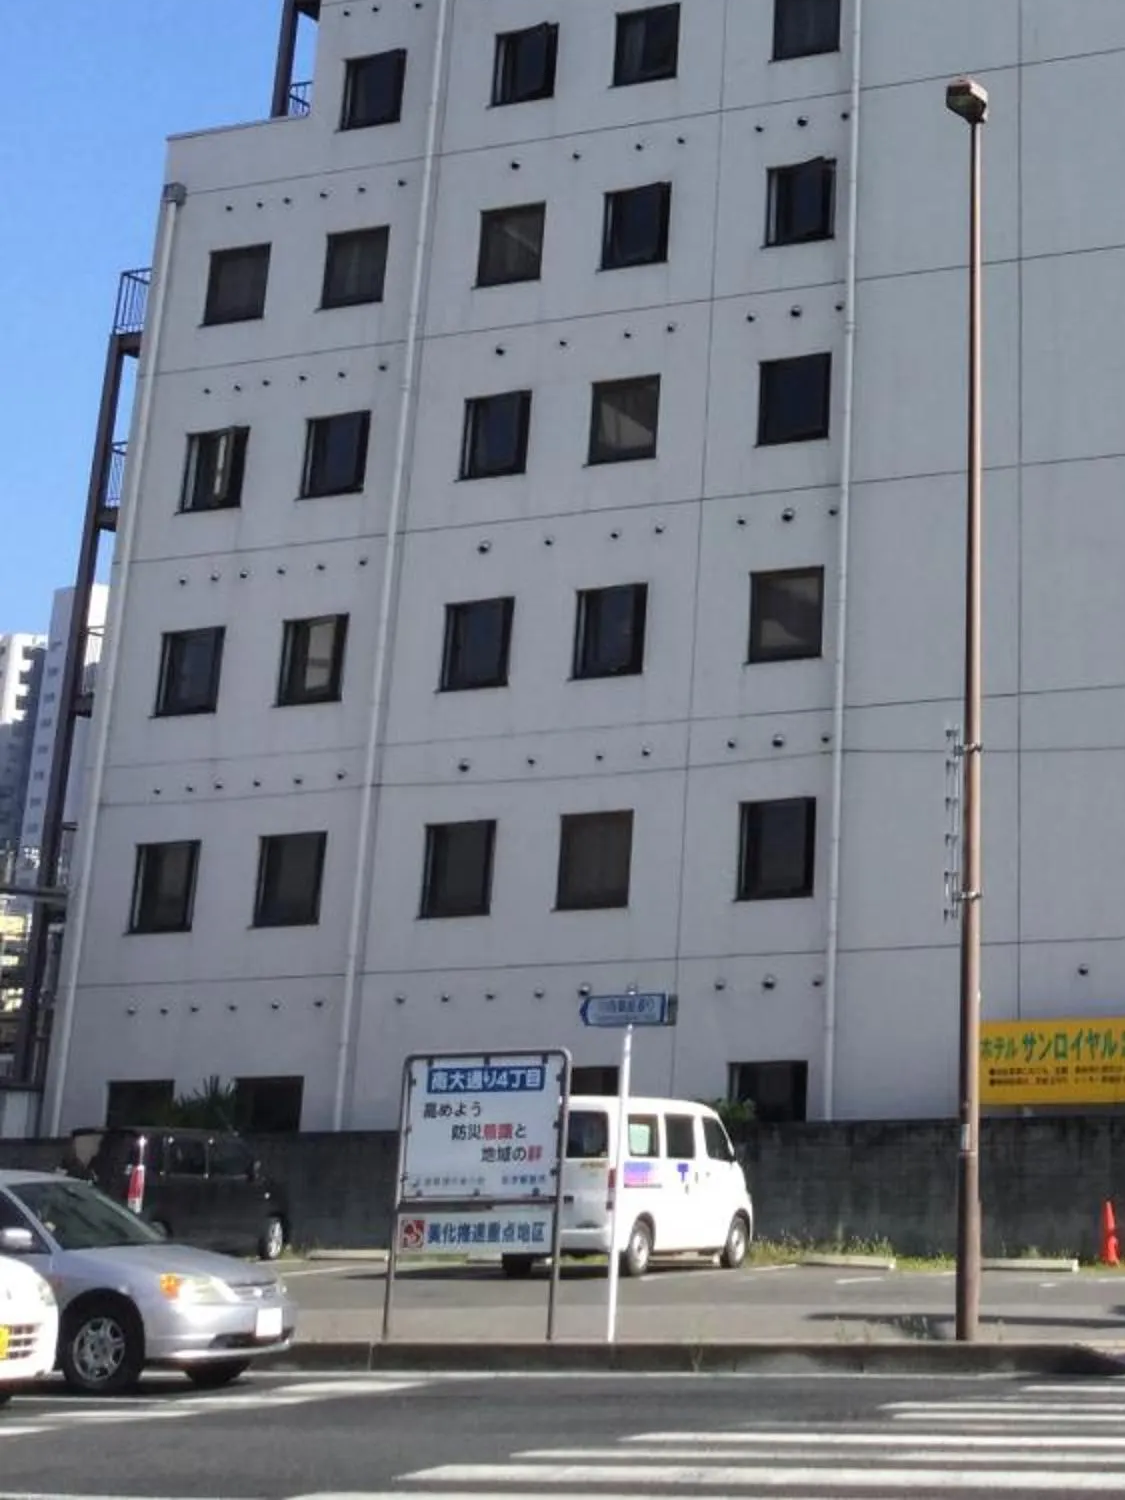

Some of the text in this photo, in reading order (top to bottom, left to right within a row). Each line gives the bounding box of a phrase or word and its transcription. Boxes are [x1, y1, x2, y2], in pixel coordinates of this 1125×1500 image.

[981, 1035, 1018, 1062] ホテル
[1023, 1028, 1117, 1062] サンロイヤル
